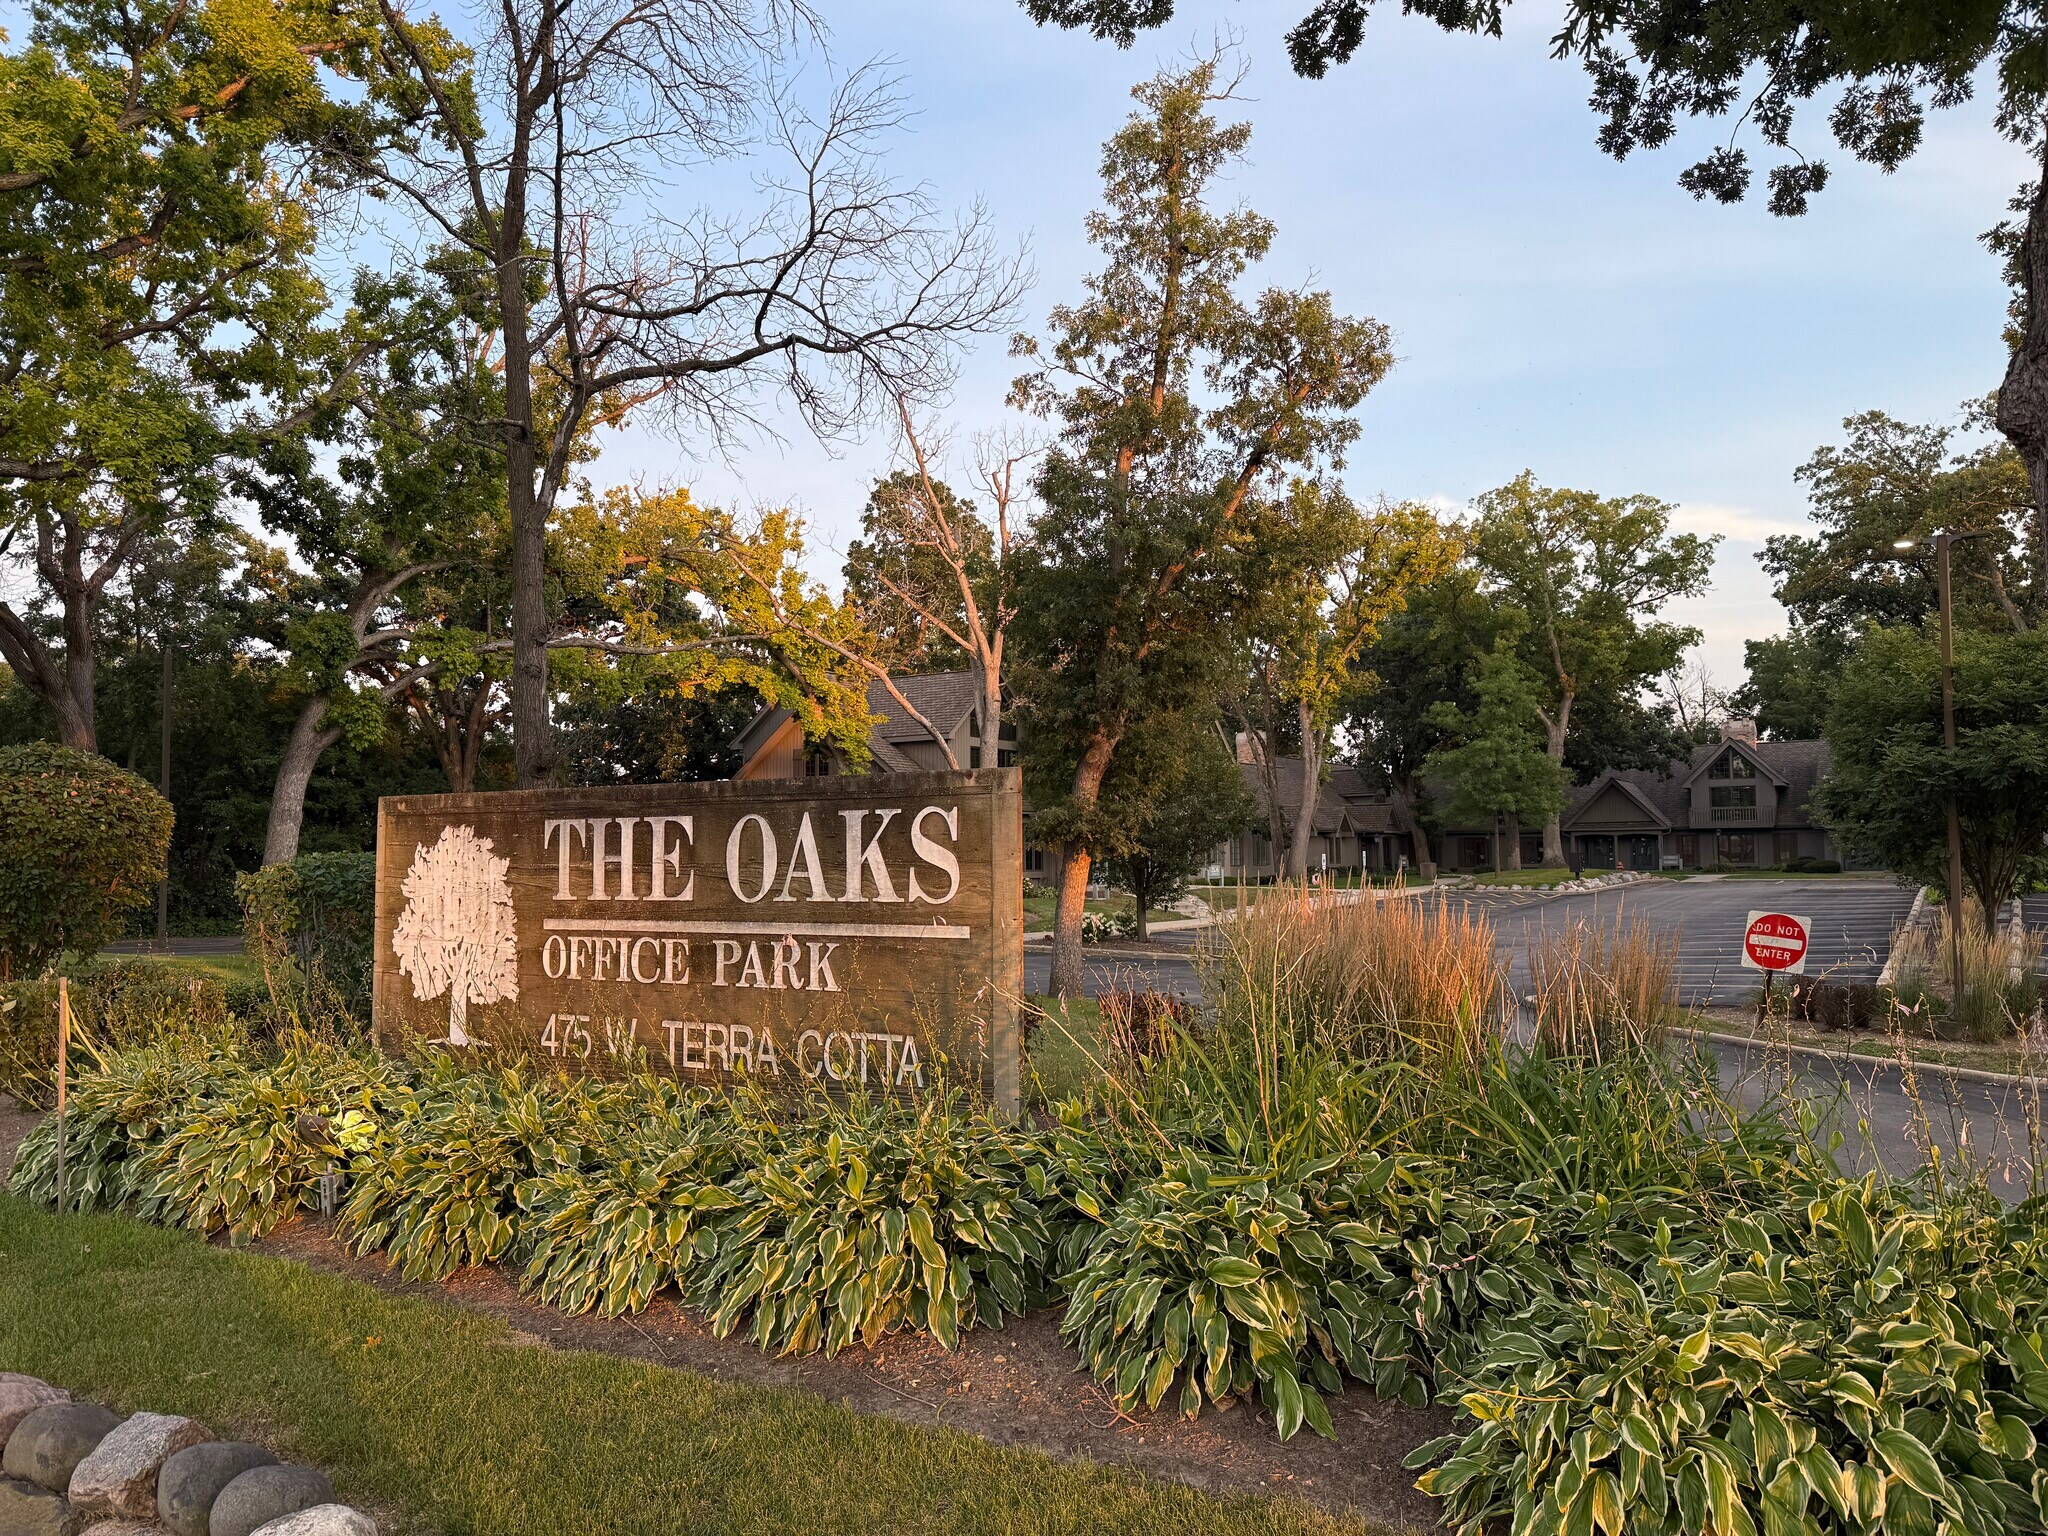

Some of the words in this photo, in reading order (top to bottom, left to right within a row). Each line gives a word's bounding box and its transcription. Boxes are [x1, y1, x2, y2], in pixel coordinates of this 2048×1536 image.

[543, 815, 695, 902] THE
[726, 805, 961, 905] OAKS
[1755, 946, 1791, 960] ENTER
[1756, 922, 1772, 933] DO
[1777, 925, 1800, 937] NOT
[542, 934, 690, 985] OFFICE
[712, 940, 841, 992] PARK
[540, 1013, 592, 1059] 475
[661, 1019, 780, 1076] TERRA
[798, 1029, 924, 1088] COTTA
